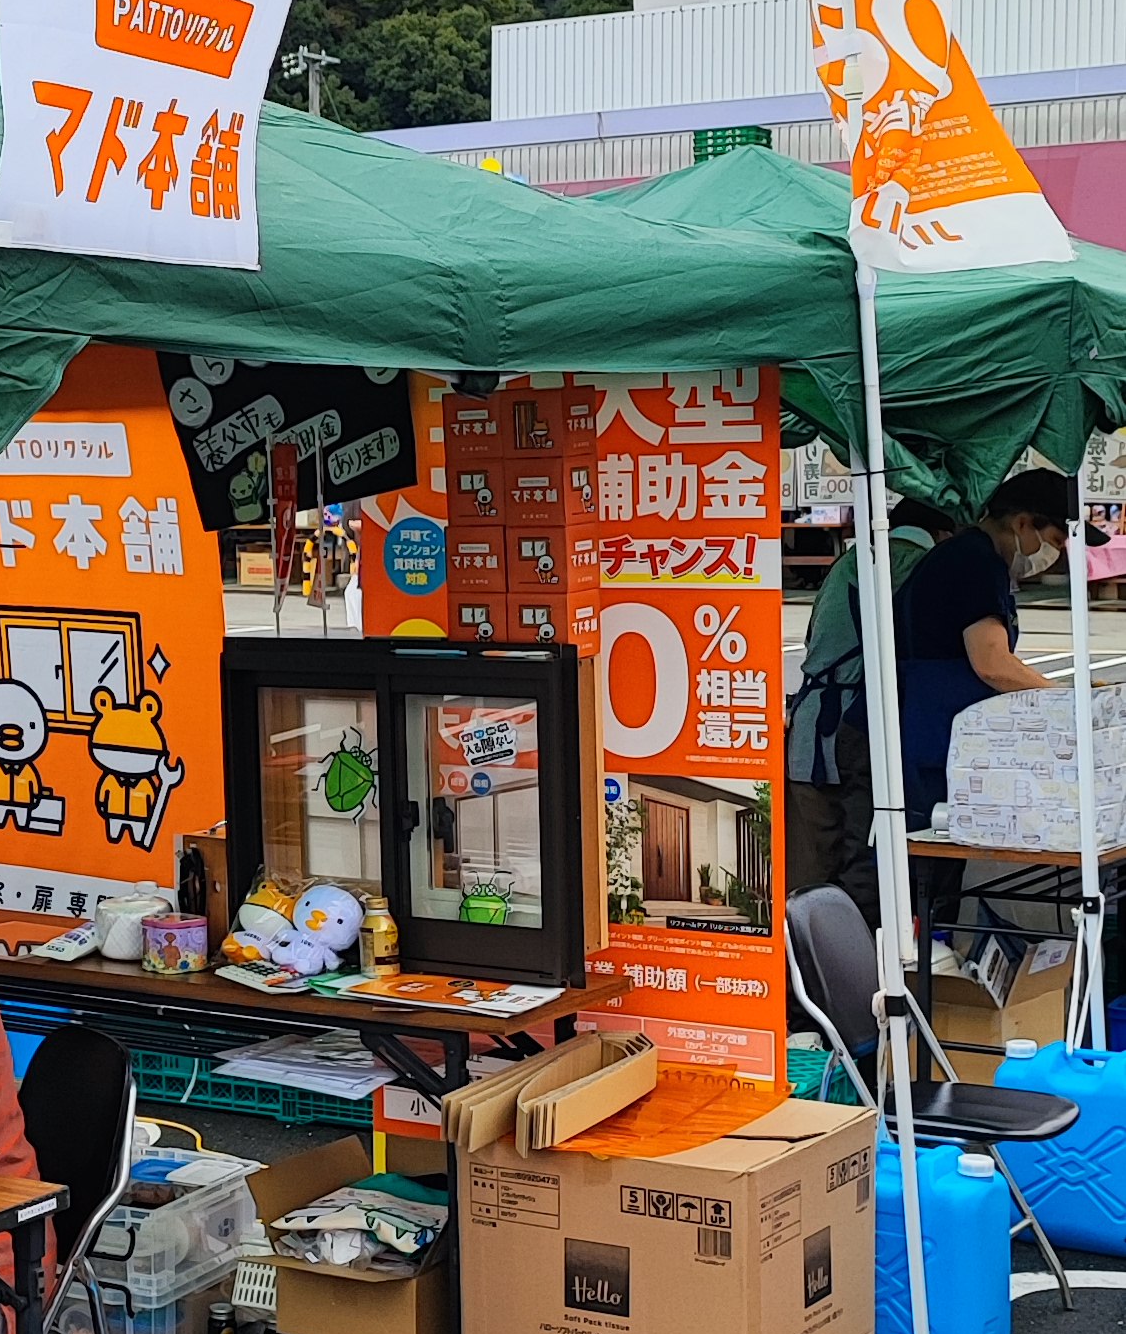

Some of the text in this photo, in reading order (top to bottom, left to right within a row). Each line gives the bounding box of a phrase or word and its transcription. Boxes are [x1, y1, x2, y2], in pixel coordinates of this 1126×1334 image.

[32, 80, 244, 220] マド本舗
[696, 669, 767, 708] 相当
[696, 710, 769, 750] 還元
[629, 1190, 639, 1203] 5
[710, 1215, 726, 1225] UP
[571, 1275, 623, 1305] Hello
[807, 1266, 829, 1299] Hello
[564, 1313, 630, 1332] Soft Pack tissue
